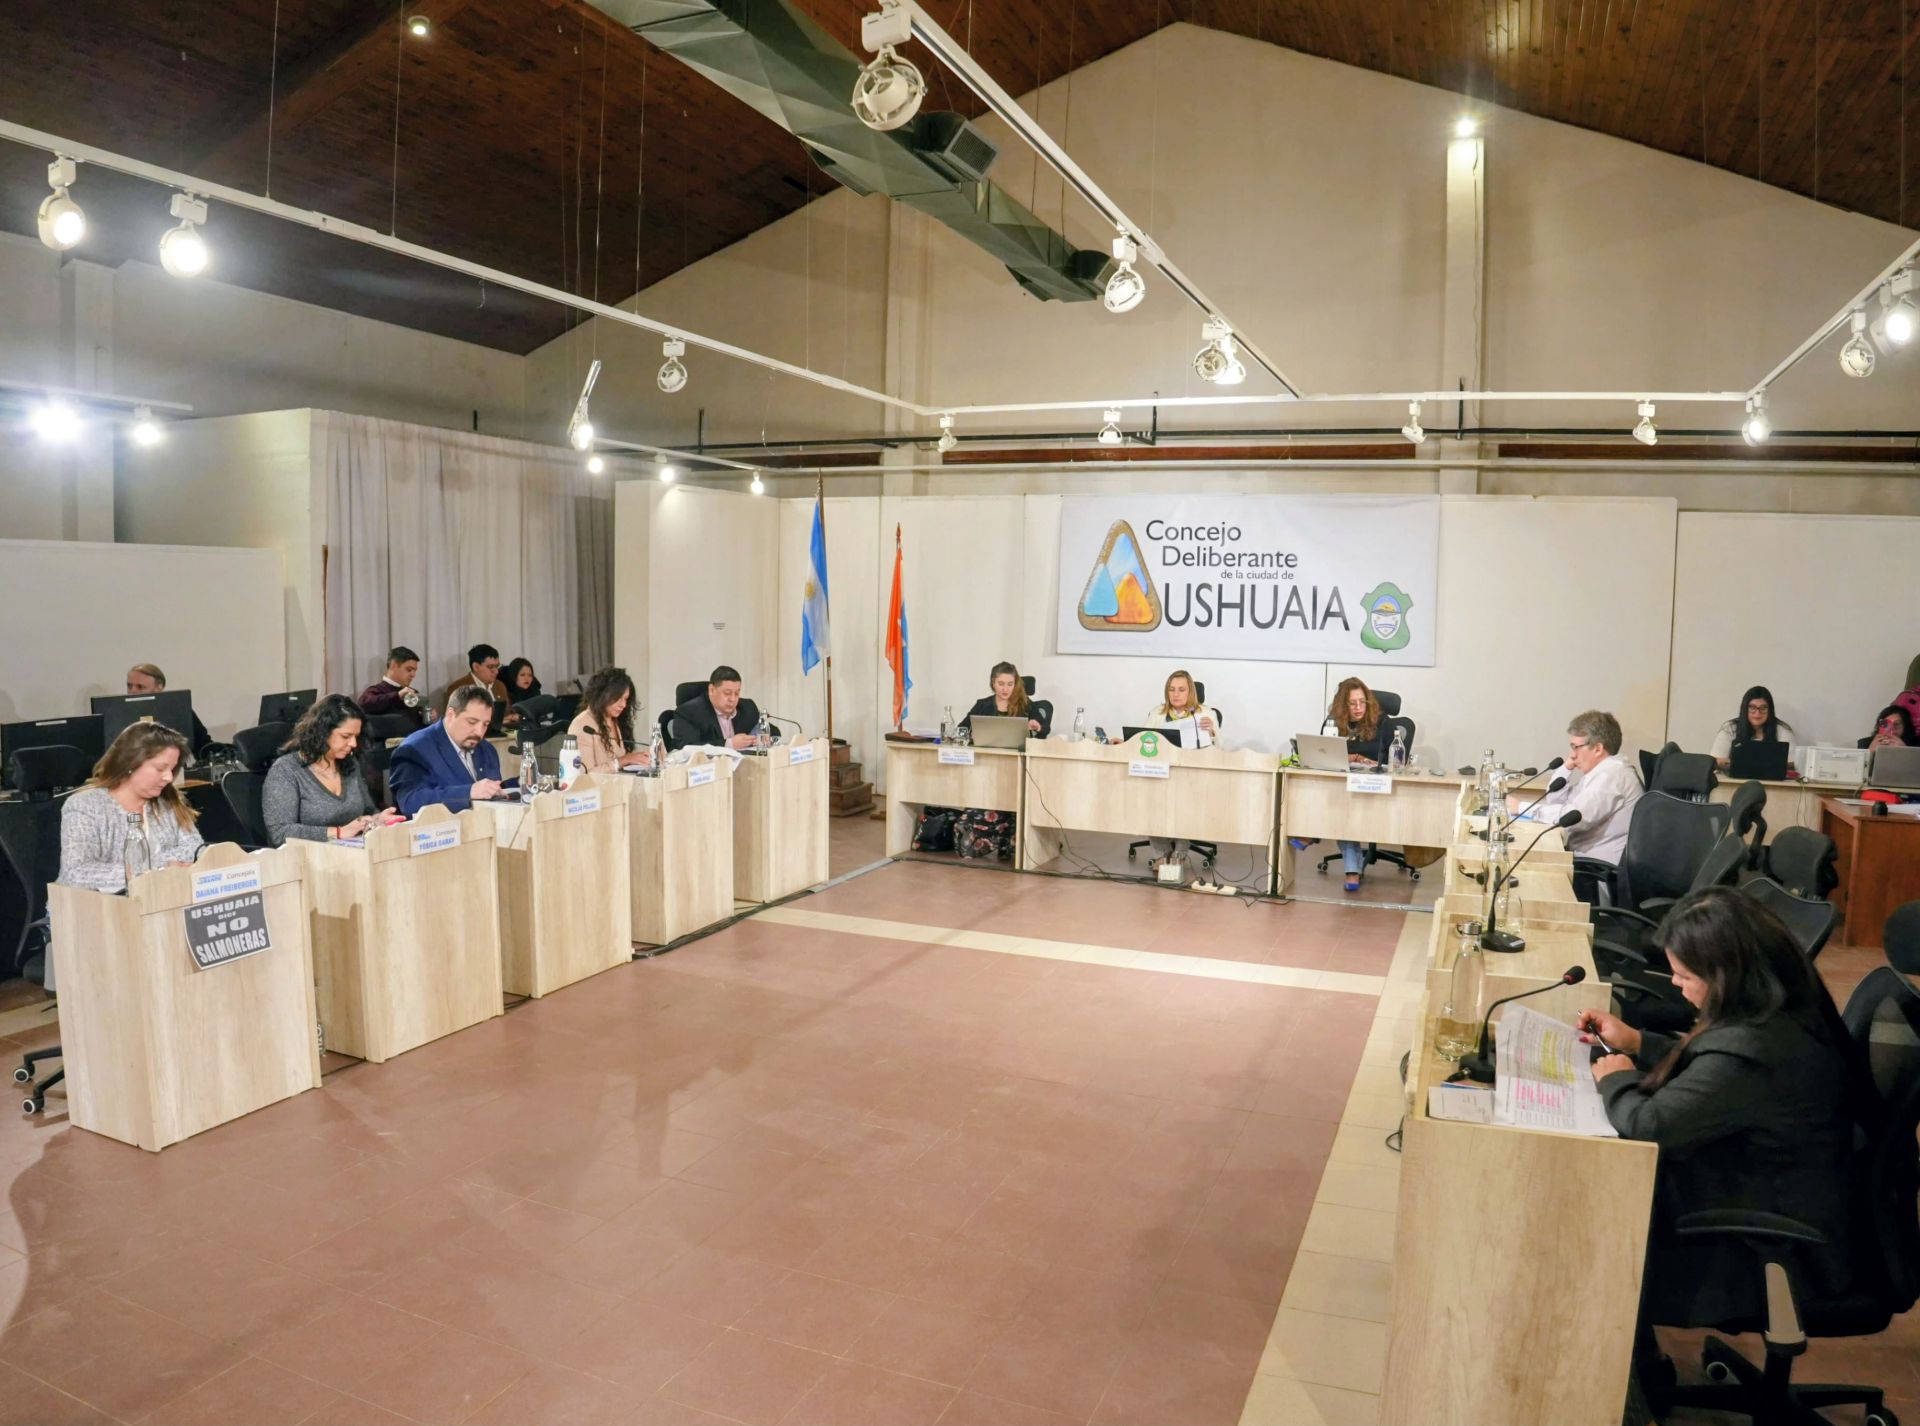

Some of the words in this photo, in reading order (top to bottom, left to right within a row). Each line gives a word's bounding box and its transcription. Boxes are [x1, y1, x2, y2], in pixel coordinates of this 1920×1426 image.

[1146, 519, 1242, 547] Concejo
[1162, 545, 1298, 569] Deliberante
[1221, 570, 1233, 579] de
[1235, 570, 1244, 579] la
[1246, 570, 1278, 580] ciudad
[1281, 570, 1294, 580] de
[1163, 582, 1350, 632] USHUAIA
[191, 895, 260, 919] USHUAIA
[206, 916, 249, 938] NO
[195, 928, 266, 963] SALMONERAS
